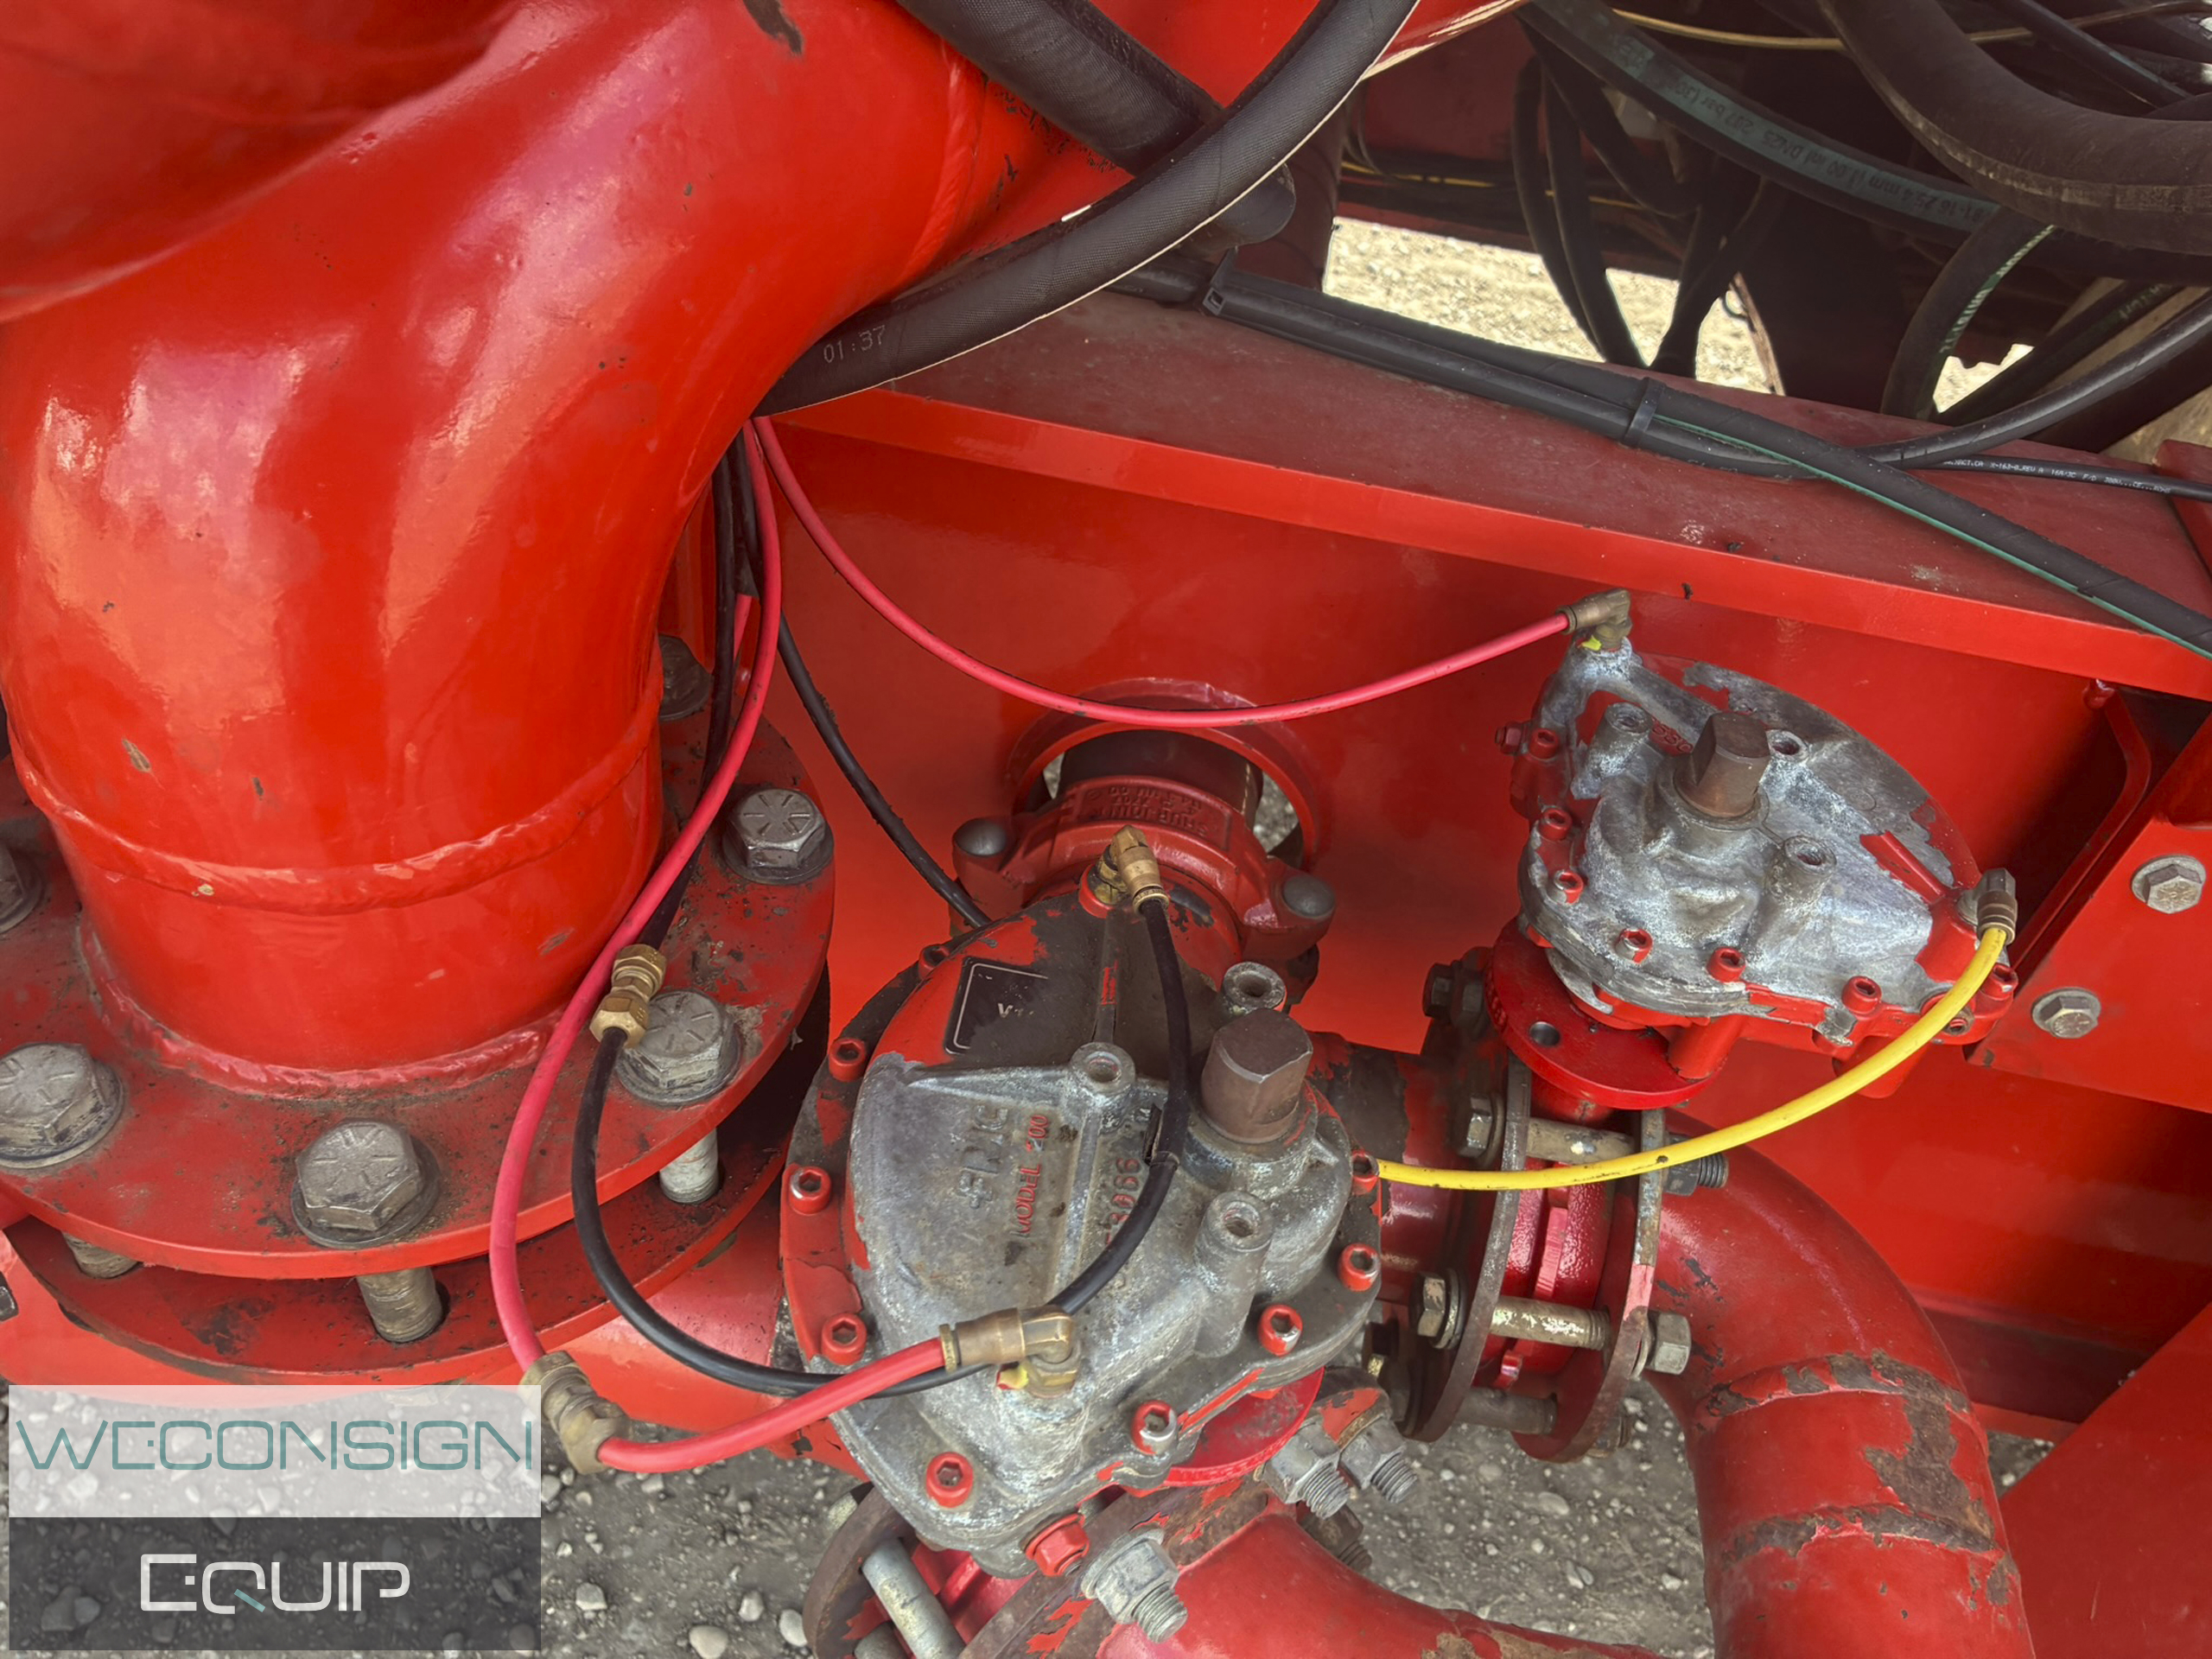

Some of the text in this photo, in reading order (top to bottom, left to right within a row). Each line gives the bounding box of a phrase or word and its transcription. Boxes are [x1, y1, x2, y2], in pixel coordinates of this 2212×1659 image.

[1700, 96, 1726, 116] bar
[1763, 131, 1804, 160] DN25
[1869, 175, 1900, 196] mm
[1010, 1114, 1050, 1238] MODEL 200
